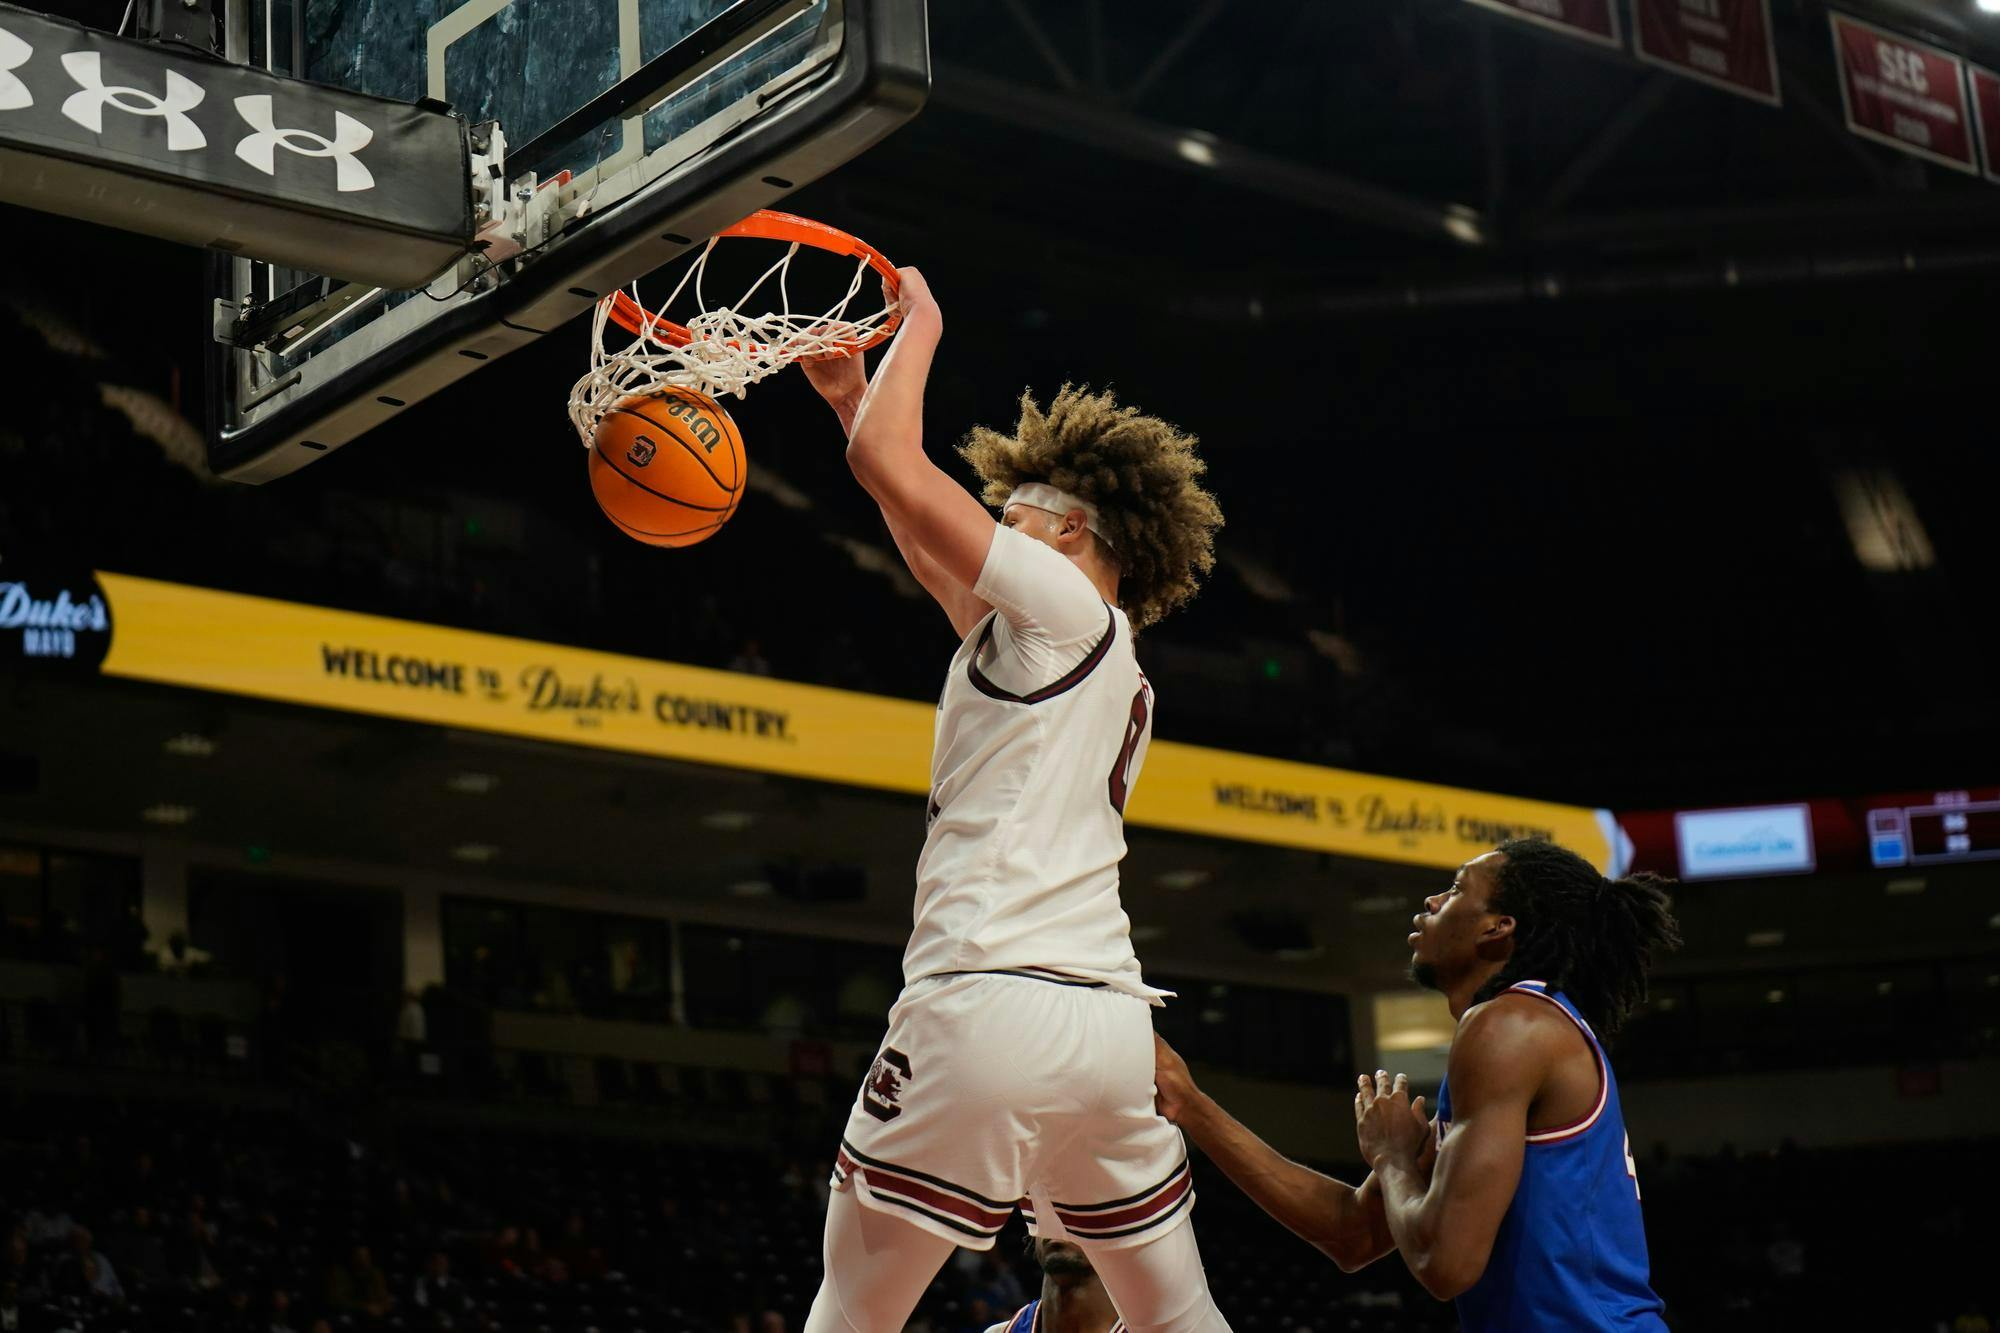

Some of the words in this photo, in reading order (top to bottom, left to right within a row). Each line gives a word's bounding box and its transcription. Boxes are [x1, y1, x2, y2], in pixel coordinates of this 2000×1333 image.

[1876, 40, 1929, 94] SEC
[321, 643, 467, 695] WELCOME
[518, 664, 641, 713] Duke's
[1211, 782, 1318, 823] WELCOME
[1355, 793, 1447, 834] Duke's
